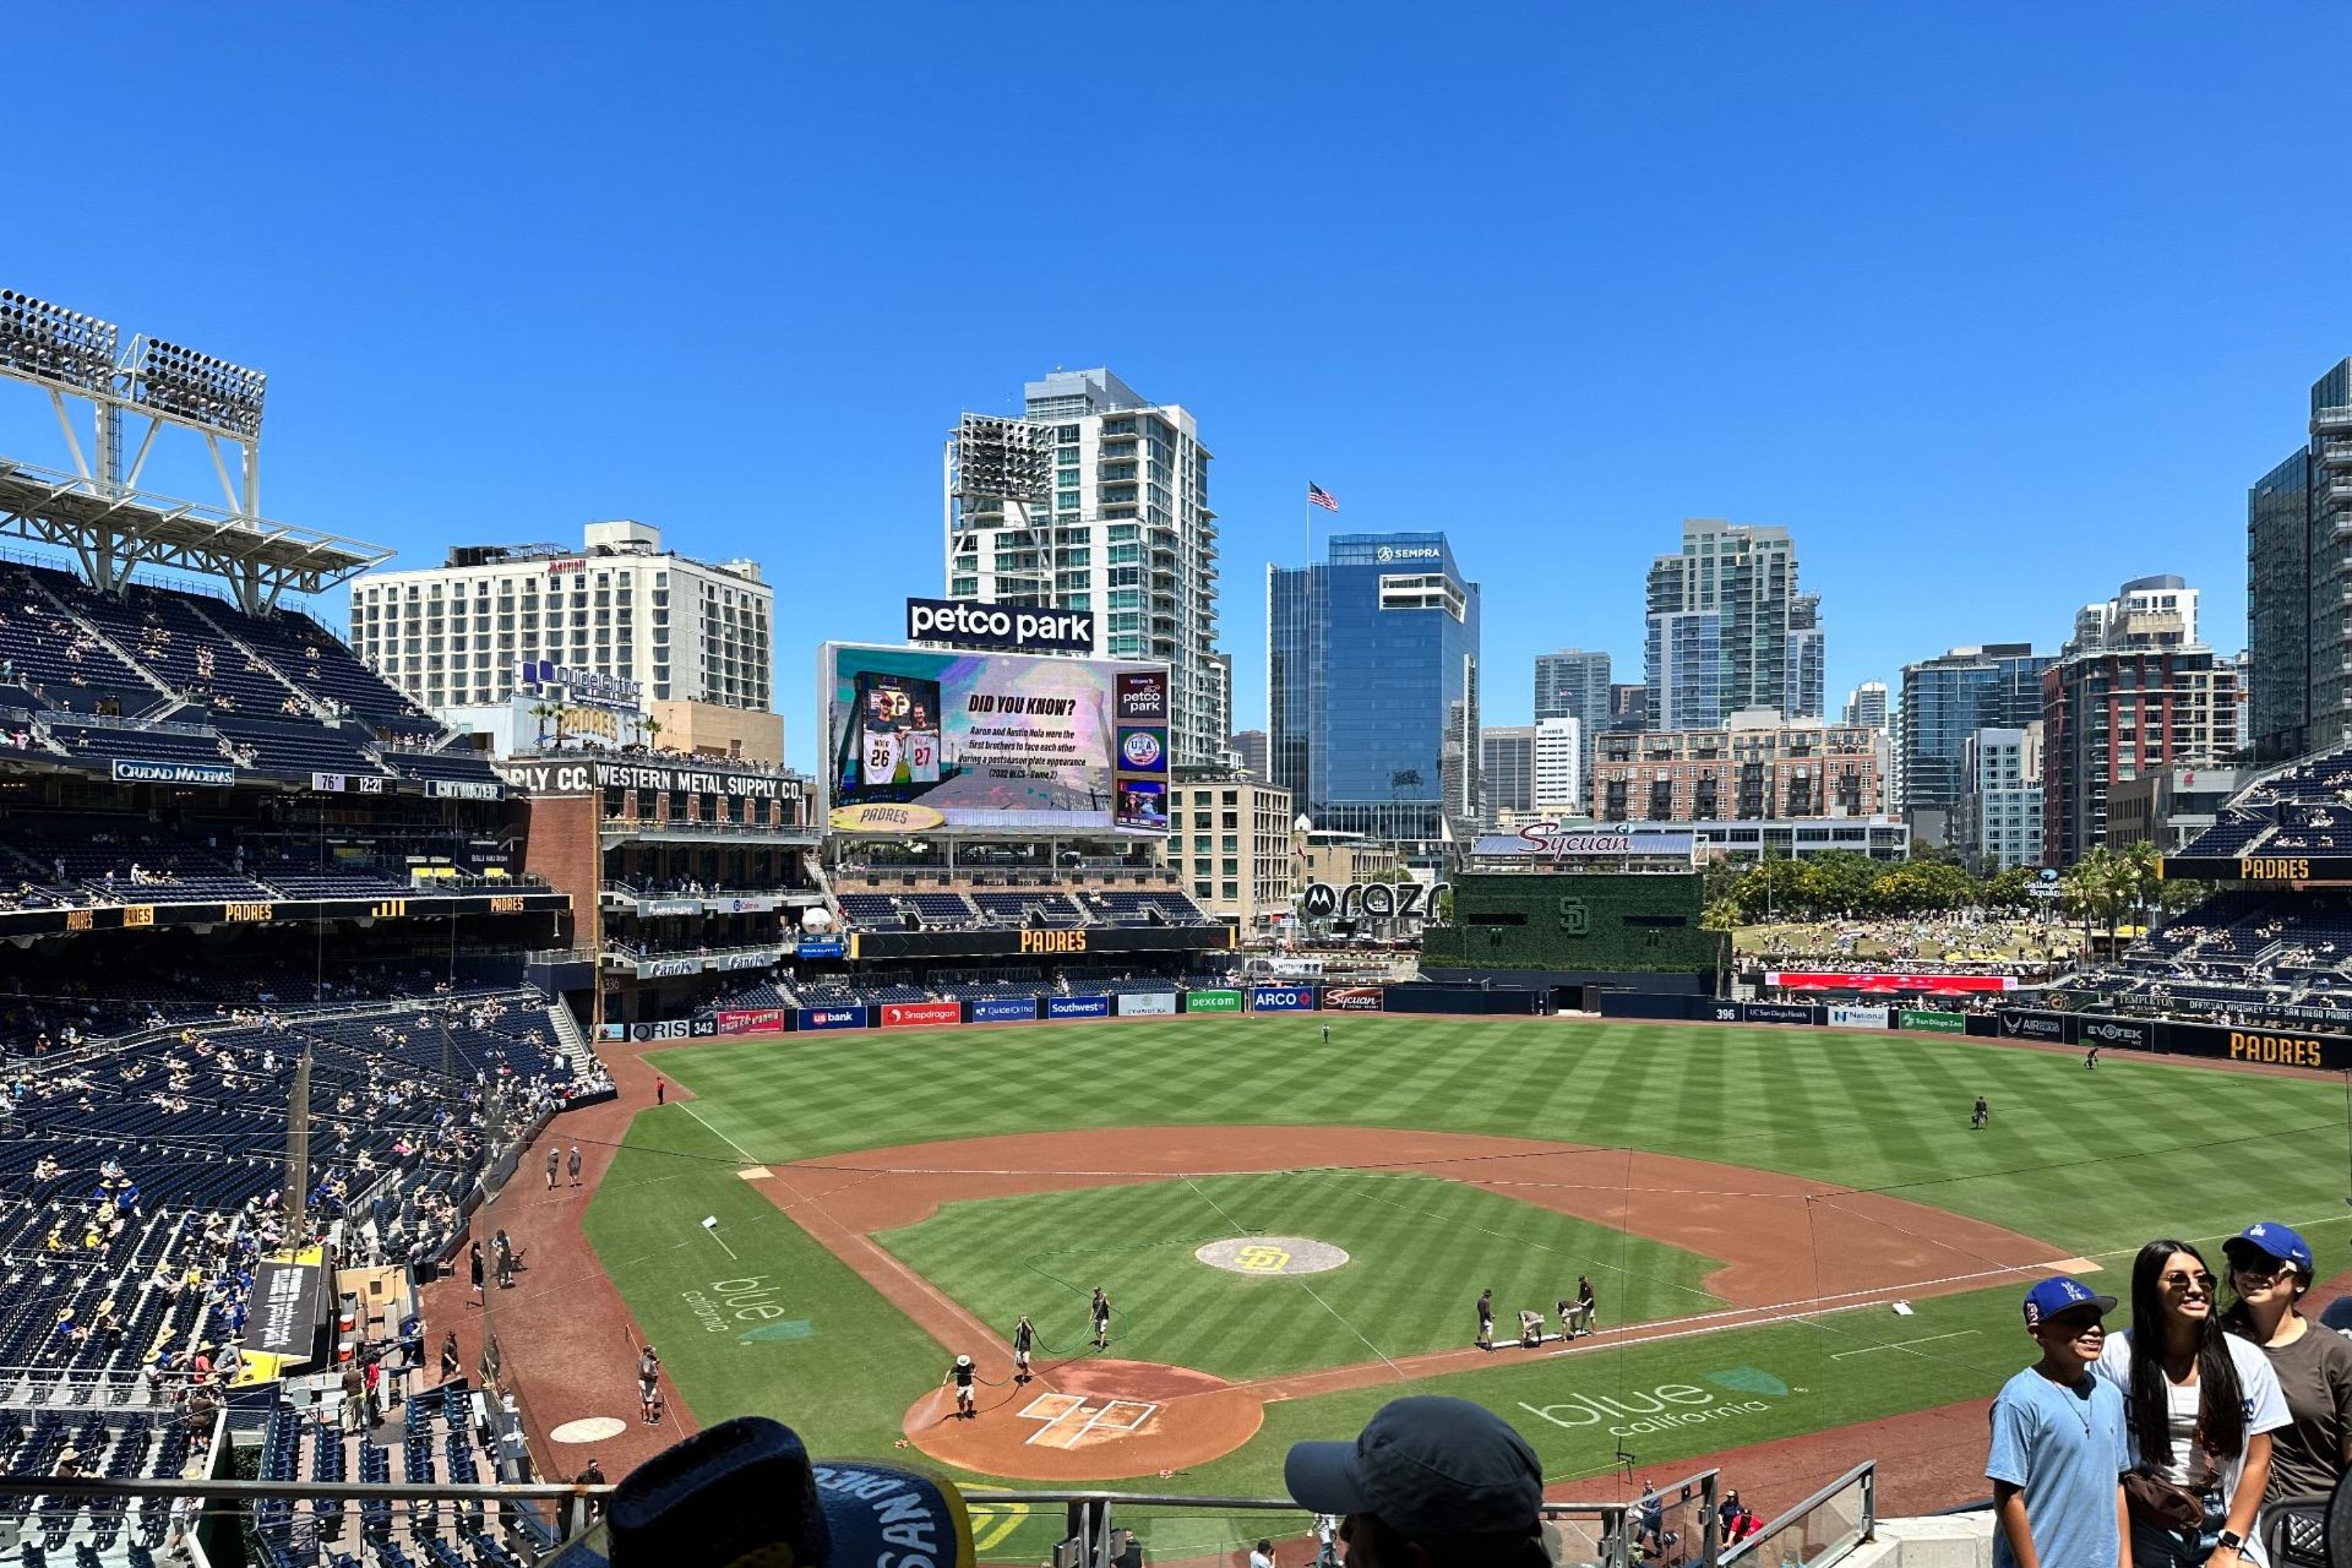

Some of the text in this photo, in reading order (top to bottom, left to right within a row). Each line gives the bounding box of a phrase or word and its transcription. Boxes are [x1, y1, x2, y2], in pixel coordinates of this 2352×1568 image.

[1395, 548, 1440, 558] SEMPRA
[912, 604, 1091, 644] petco park
[969, 694, 1076, 716] DID YOU KNOW?
[1123, 691, 1160, 703] petco
[1131, 702, 1160, 713] park
[970, 726, 1075, 739] Aaron and Austin Nola were the
[969, 740, 1076, 753] first brothers to face each other
[871, 750, 890, 767] 26
[915, 747, 931, 767] 27
[958, 754, 982, 764] during
[988, 755, 1027, 765] postseason
[1028, 756, 1046, 767] plate
[1047, 757, 1086, 767] appearance
[118, 764, 232, 783] CIUDAD MADERAS
[557, 767, 593, 790] CO.
[597, 764, 802, 800] WESTERN METAL SUPPLY CO.
[359, 778, 382, 793] 12:21
[860, 808, 908, 824] PADRES
[1518, 822, 1633, 861] Sycuan
[2241, 858, 2309, 879] PADRES
[492, 898, 524, 913] PADRES
[1341, 882, 1450, 917] razr
[67, 911, 93, 931] PADRES
[225, 904, 273, 921] PADRES
[1021, 930, 1086, 953] PADRES
[604, 978, 619, 990] 336
[1255, 993, 1297, 1005] ARCO
[1326, 989, 1376, 1009] Sycuan
[2119, 995, 2175, 1007] TEMPLETON
[828, 1011, 852, 1022] bank
[905, 1010, 956, 1020] Snapdragon
[1052, 1004, 1098, 1013] Southwest
[1717, 1008, 1735, 1019] 396
[1849, 1011, 1884, 1020] National
[2190, 1000, 2224, 1011] OFFICIAL
[2227, 1003, 2263, 1014] WHISKEY
[2301, 1008, 2324, 1018] DIEGO
[2326, 1011, 2352, 1020] PADRE
[633, 1022, 688, 1040] ORIS
[695, 1022, 713, 1035] 342
[2024, 1019, 2039, 1031] AIR
[2087, 1024, 2143, 1040] EVOTEK
[2230, 1033, 2321, 1067] PADRES
[710, 1275, 785, 1320] blue
[681, 1290, 731, 1333] california
[1517, 1385, 1714, 1428] blue
[1609, 1400, 1771, 1436] california
